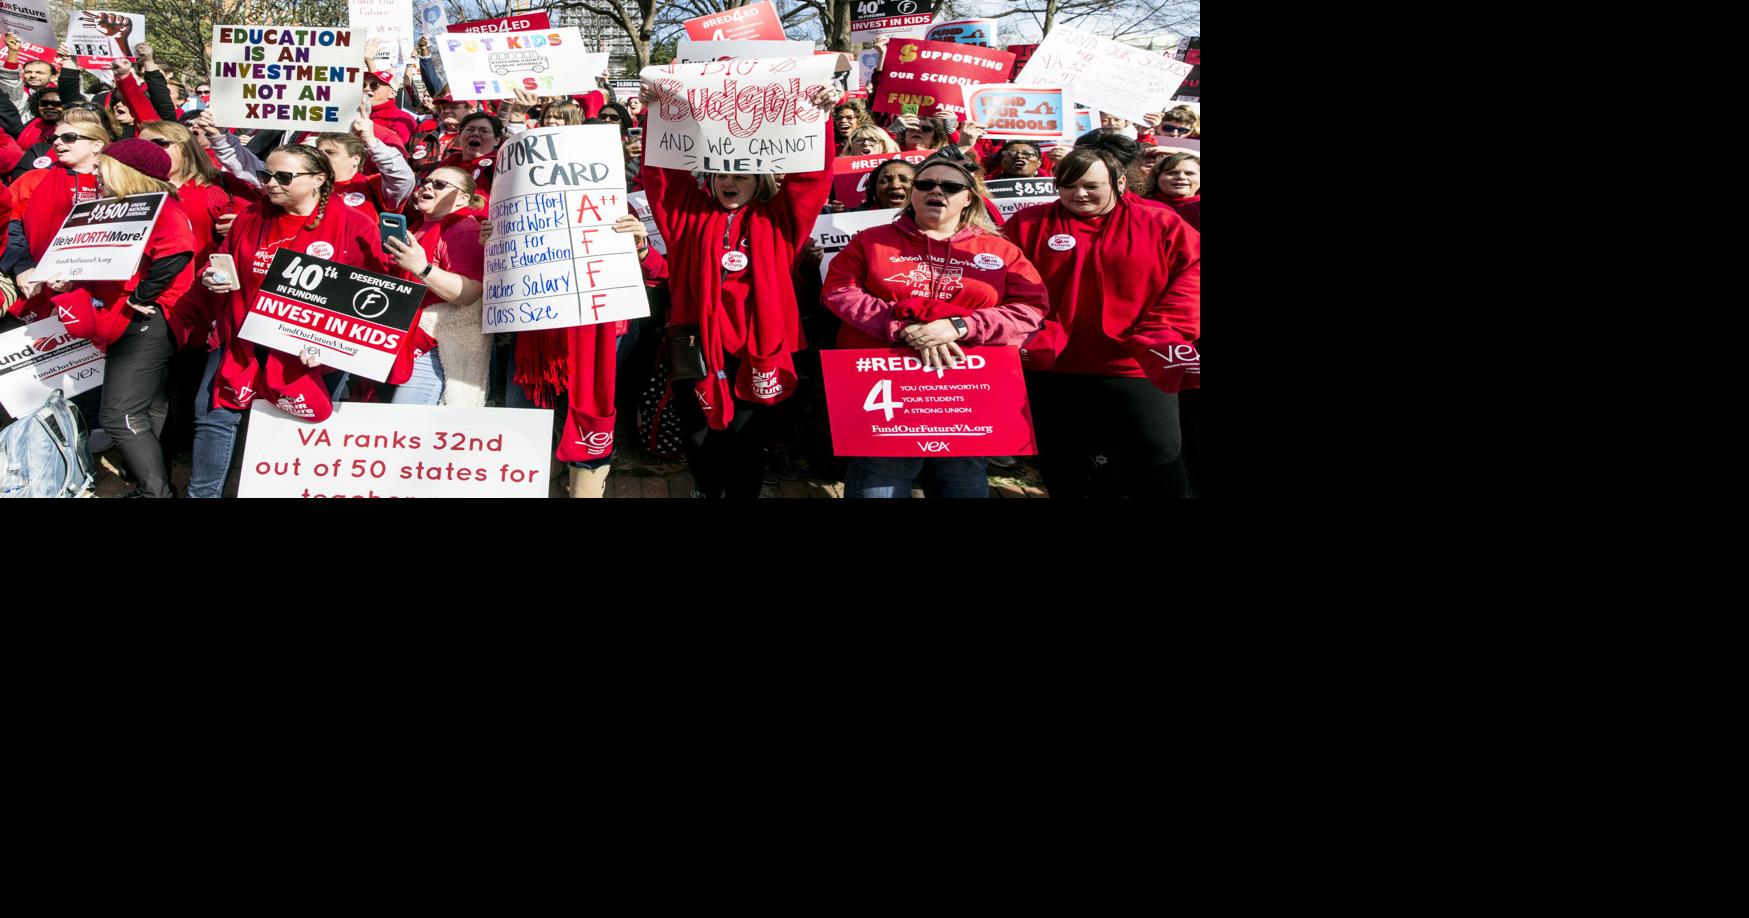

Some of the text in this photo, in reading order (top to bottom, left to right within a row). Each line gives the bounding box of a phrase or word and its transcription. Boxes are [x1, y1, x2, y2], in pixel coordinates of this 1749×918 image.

[702, 8, 759, 29] #RED4ED
[852, 15, 930, 30] INVEST IN KIDS
[220, 28, 352, 47] EDUCATION
[446, 33, 563, 53] PUT KIDS
[244, 46, 310, 63] IS AN
[215, 62, 360, 84] INVESTMENT
[889, 71, 915, 80] OUR
[243, 84, 331, 102] NOT AN
[888, 92, 935, 106] FUND
[981, 96, 1026, 107] FUND
[245, 103, 339, 123] XPENSE
[653, 77, 822, 138] Budgets
[983, 107, 1019, 118] OUR
[987, 118, 1057, 131] SCHOOLS
[659, 131, 695, 152] AND
[749, 134, 819, 156] CANNOT
[529, 162, 609, 187] CARD
[704, 156, 763, 172] LIE!
[88, 203, 128, 223] $8,500
[525, 192, 564, 214] Effort
[527, 211, 565, 232] Work
[486, 235, 545, 257] Funding for
[582, 229, 598, 255] F
[511, 247, 571, 268] Education
[889, 255, 922, 263] School
[281, 256, 339, 291] 40th
[350, 272, 412, 295] DESERVES AN
[523, 271, 570, 297] Salary
[586, 260, 604, 288] F
[276, 284, 328, 304] IN FUNDING
[361, 294, 381, 310] F
[487, 302, 558, 326] Class Size
[591, 294, 607, 321] F
[256, 296, 400, 349] INVEST IN KIDS
[0, 345, 35, 366] und
[980, 383, 991, 391] IT)
[863, 379, 904, 422] 4
[872, 424, 993, 434] FundOurFutureVA.org
[298, 428, 503, 452] VA ranks 32nd
[255, 457, 540, 483] out of 50 states for
